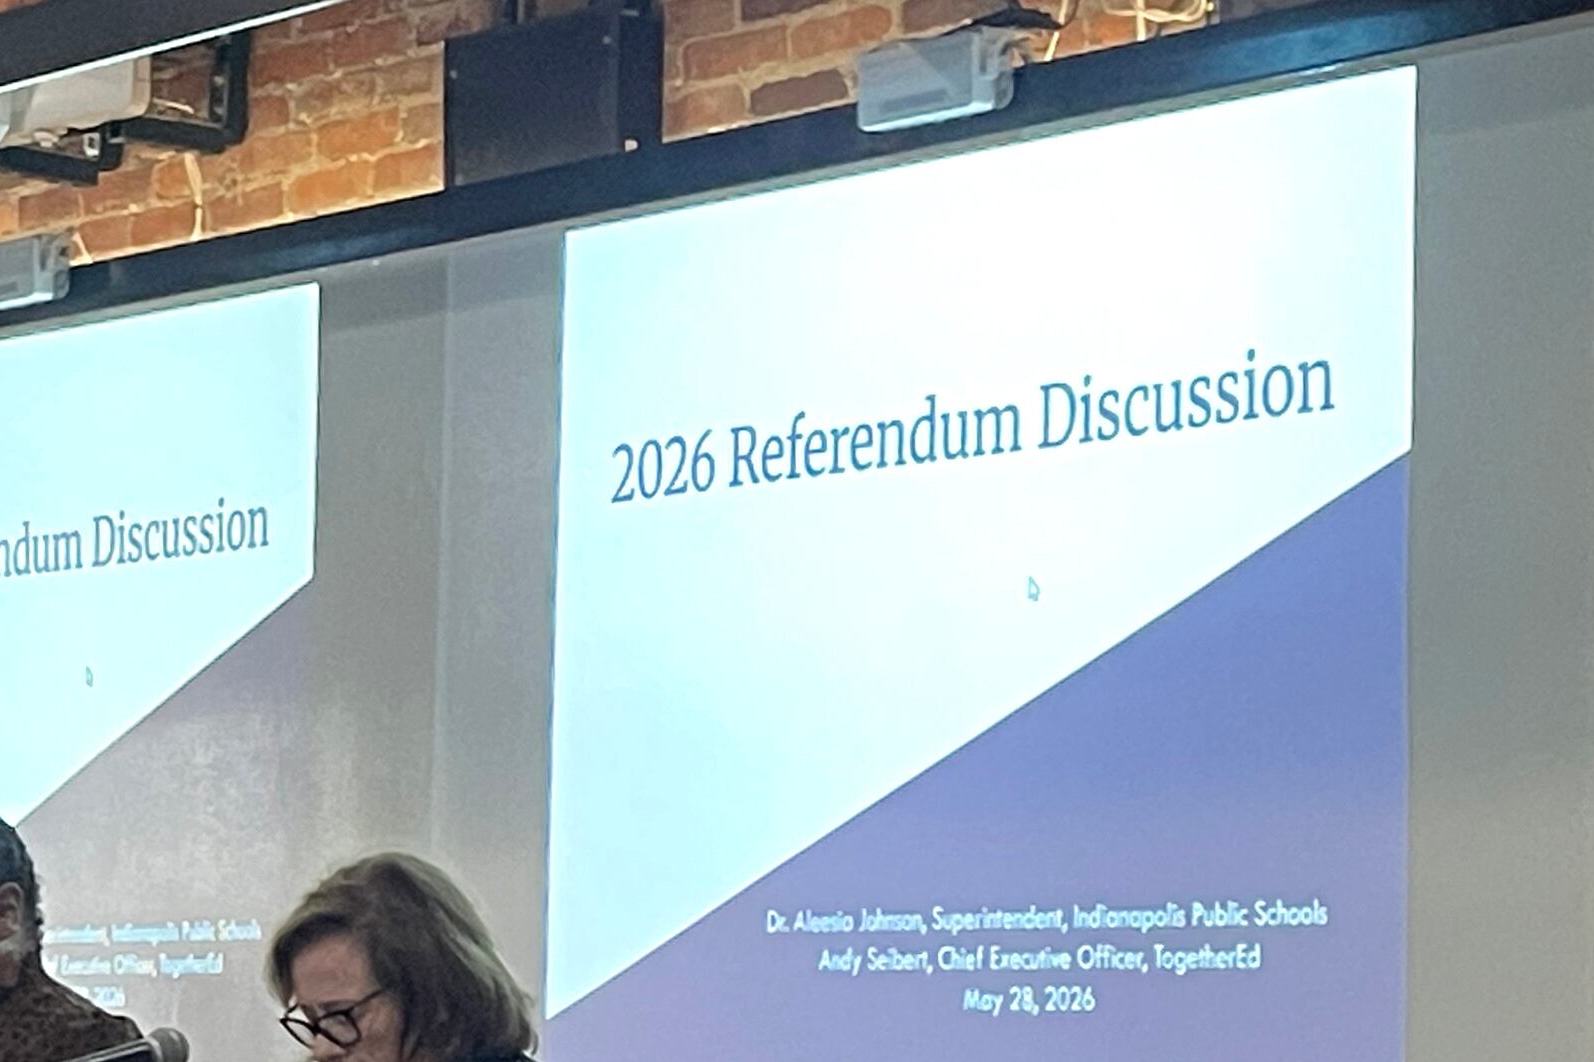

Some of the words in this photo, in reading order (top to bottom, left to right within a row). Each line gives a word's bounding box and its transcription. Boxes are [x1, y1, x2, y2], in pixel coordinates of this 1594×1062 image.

[610, 429, 715, 502] 2026
[729, 395, 1022, 487] Referendum
[1039, 349, 1334, 449] Discussion
[92, 497, 269, 567] Discussion
[767, 909, 790, 933] Dr.
[794, 908, 854, 932] Aleesia
[859, 907, 928, 935] Johnson,
[931, 905, 1068, 936] Superintendent,
[1073, 902, 1186, 934] Indianapolis
[1191, 901, 1249, 927] Public
[1254, 898, 1328, 926] Schools
[818, 947, 862, 976] Andy
[867, 946, 933, 975] Seibert,
[938, 945, 984, 970] Chief
[989, 944, 1072, 970] Executive
[1077, 943, 1149, 973] Officer,
[1154, 943, 1262, 975] TogetherEd
[963, 987, 1004, 1017] May
[1009, 986, 1039, 1016] 28,
[1044, 985, 1096, 1011] 2026
